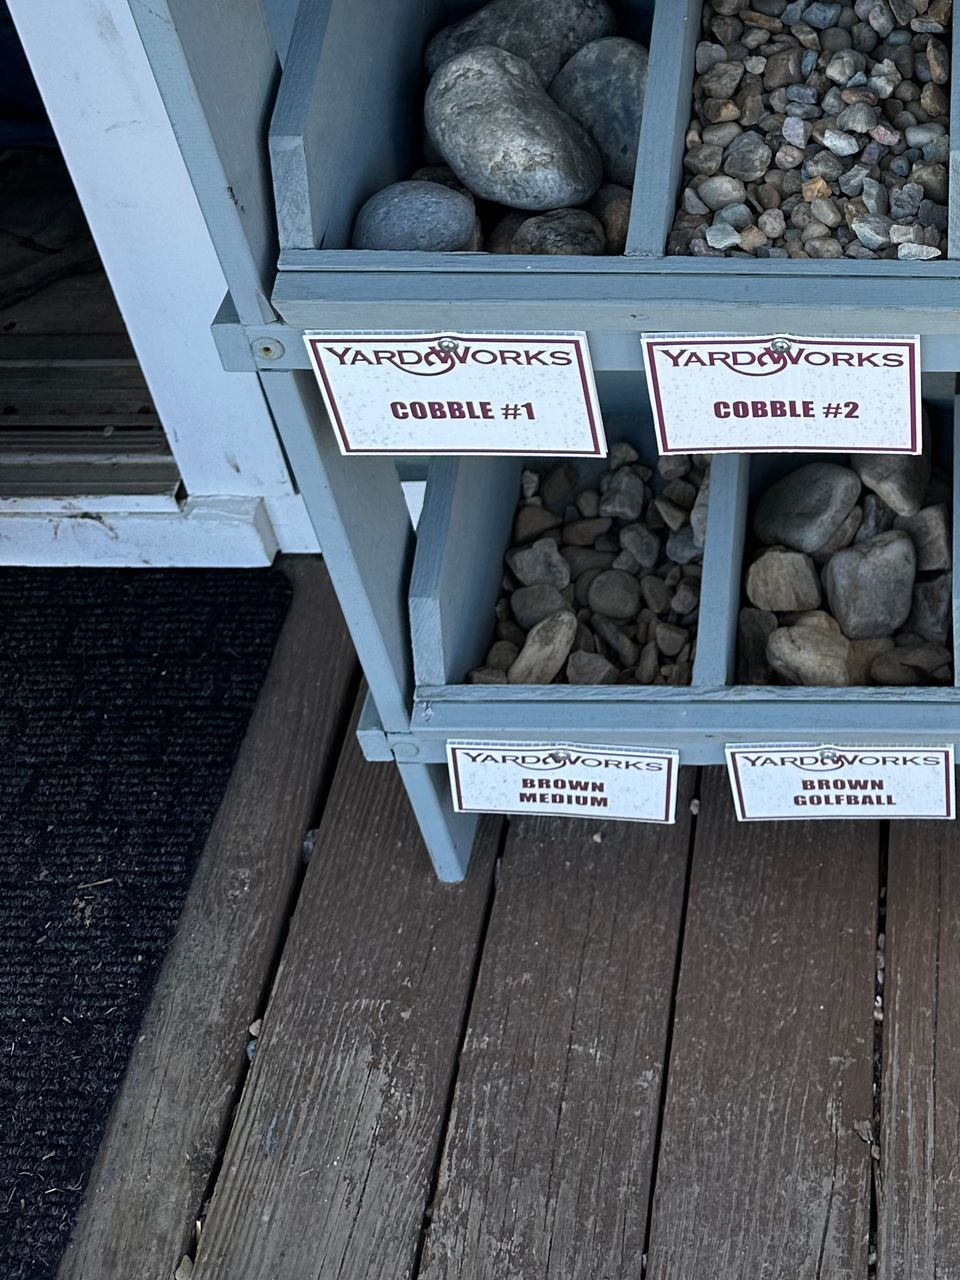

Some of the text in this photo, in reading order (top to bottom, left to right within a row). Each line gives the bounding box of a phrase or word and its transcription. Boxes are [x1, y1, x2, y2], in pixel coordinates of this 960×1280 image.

[390, 401, 535, 420] COBBLE #1
[713, 400, 860, 419] COBBLE #2
[522, 778, 605, 793] BROWN
[801, 779, 884, 791] BROWN
[519, 792, 608, 808] MEDIUM
[793, 794, 896, 806] GOLFBALL
